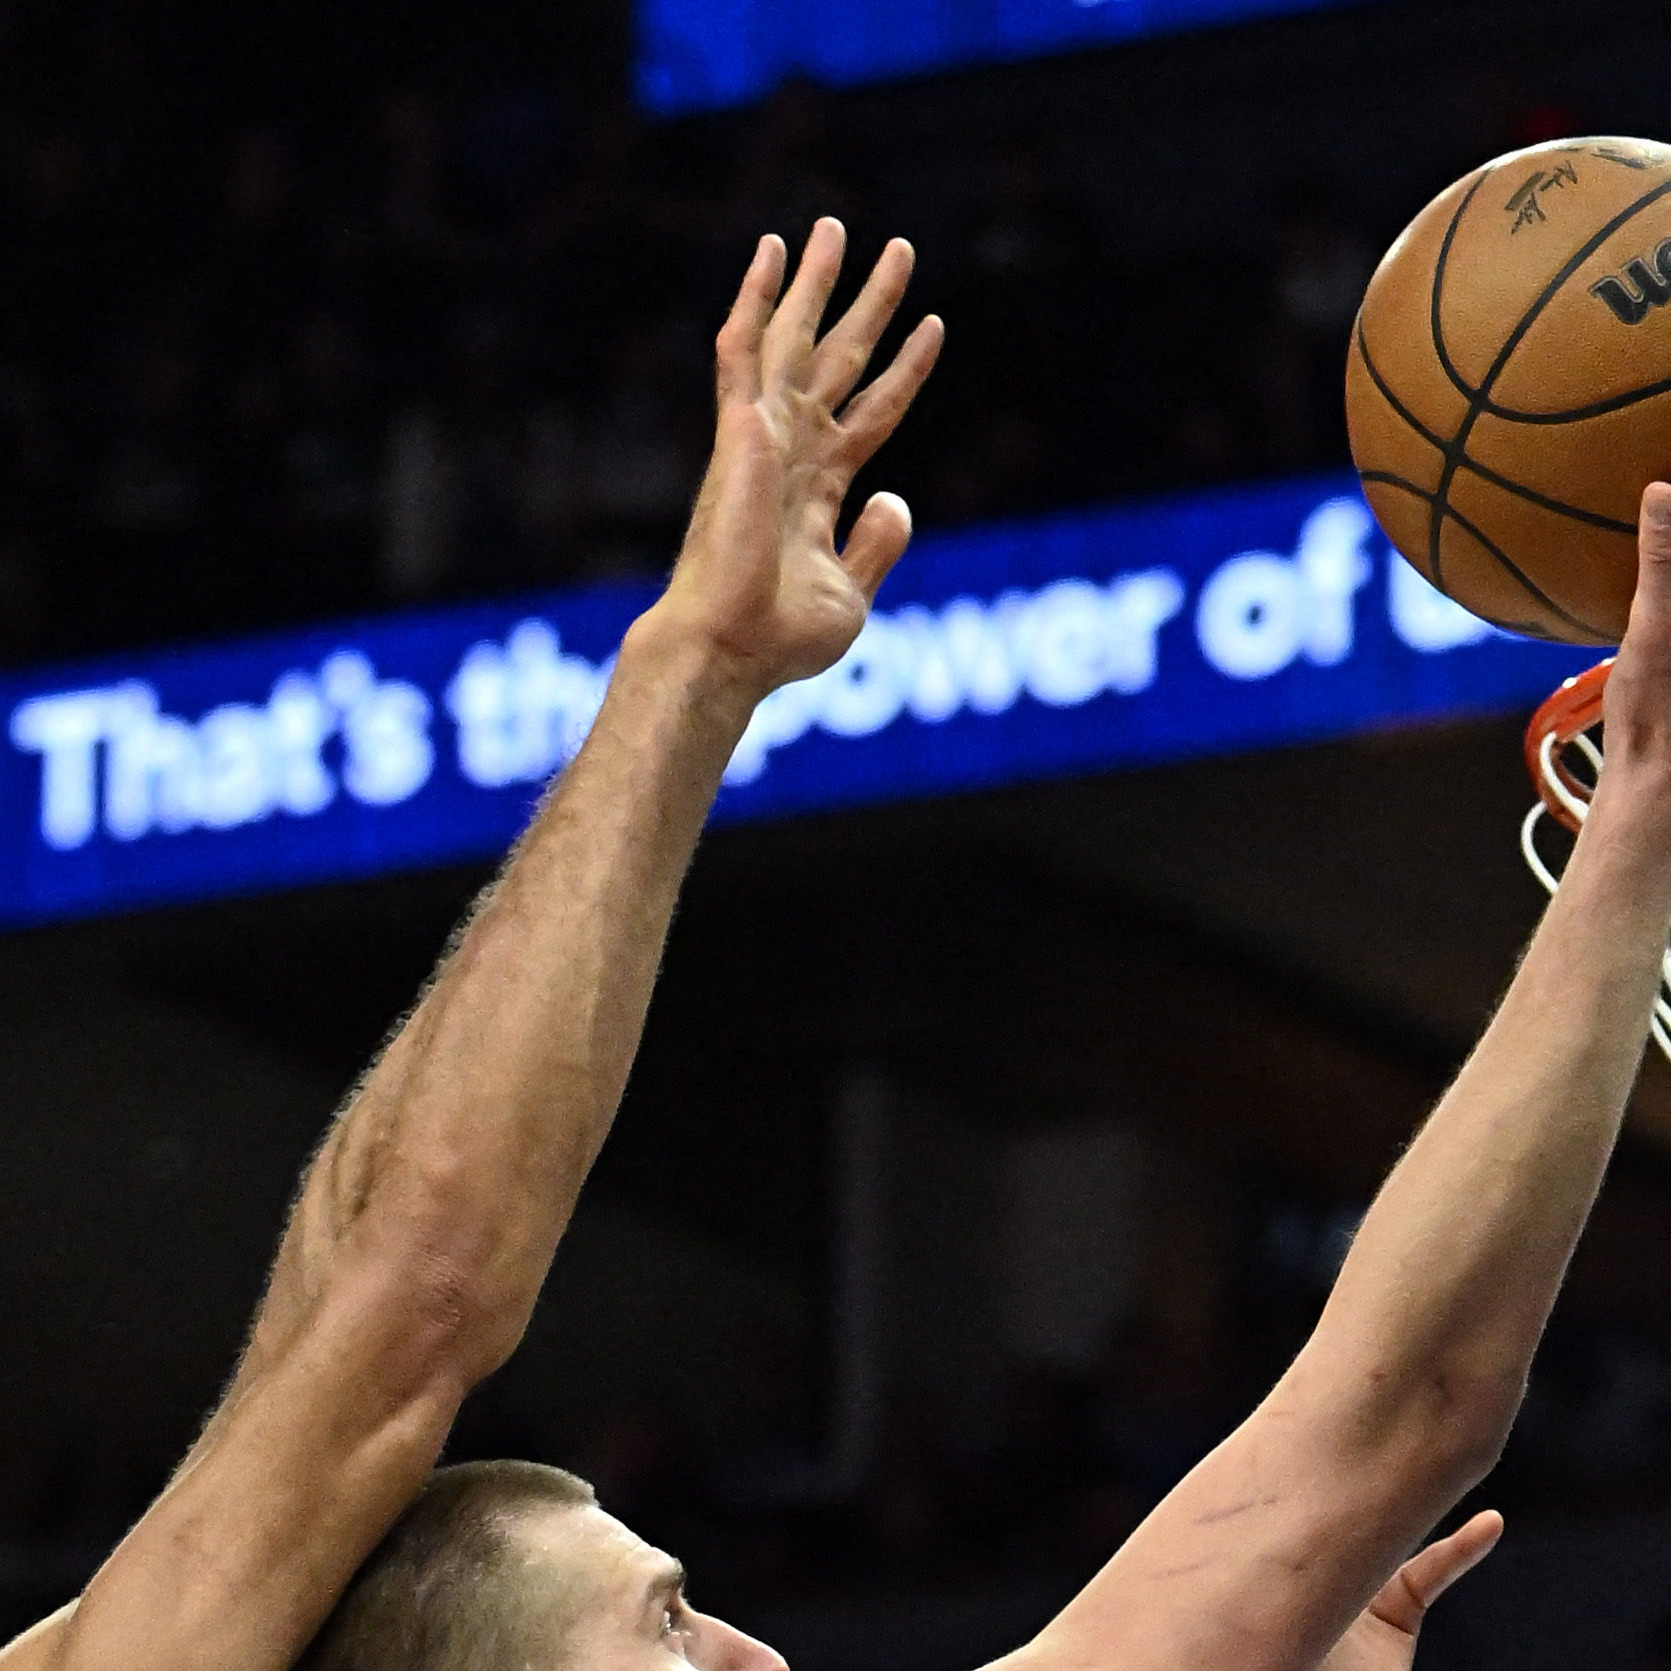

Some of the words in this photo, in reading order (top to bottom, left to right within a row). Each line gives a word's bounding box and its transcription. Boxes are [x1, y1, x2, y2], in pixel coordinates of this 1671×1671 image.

[9, 648, 434, 851] That's
[446, 616, 624, 788] th
[1195, 496, 1375, 682] of
